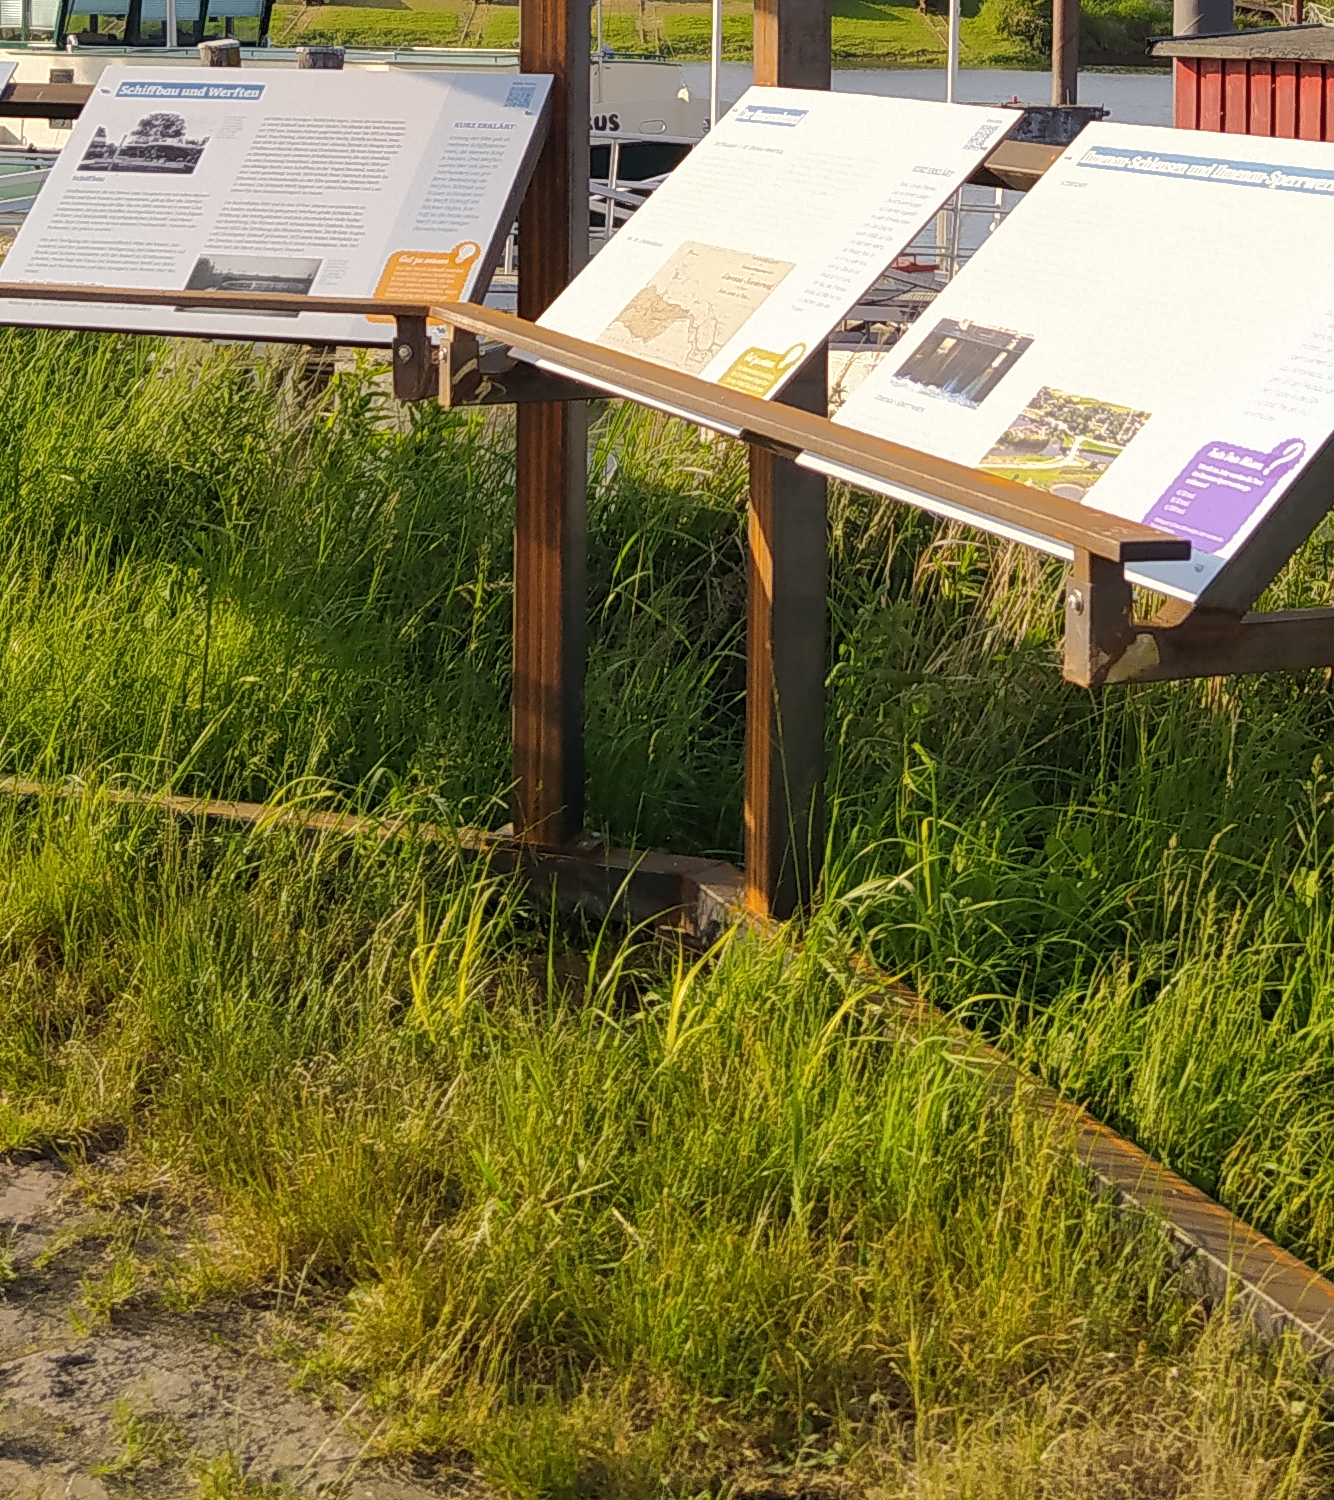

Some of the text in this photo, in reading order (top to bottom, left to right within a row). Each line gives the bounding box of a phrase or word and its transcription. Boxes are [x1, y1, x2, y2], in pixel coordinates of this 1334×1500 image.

[119, 85, 259, 97] Schiffbau und Werften
[1186, 163, 1218, 178] und
